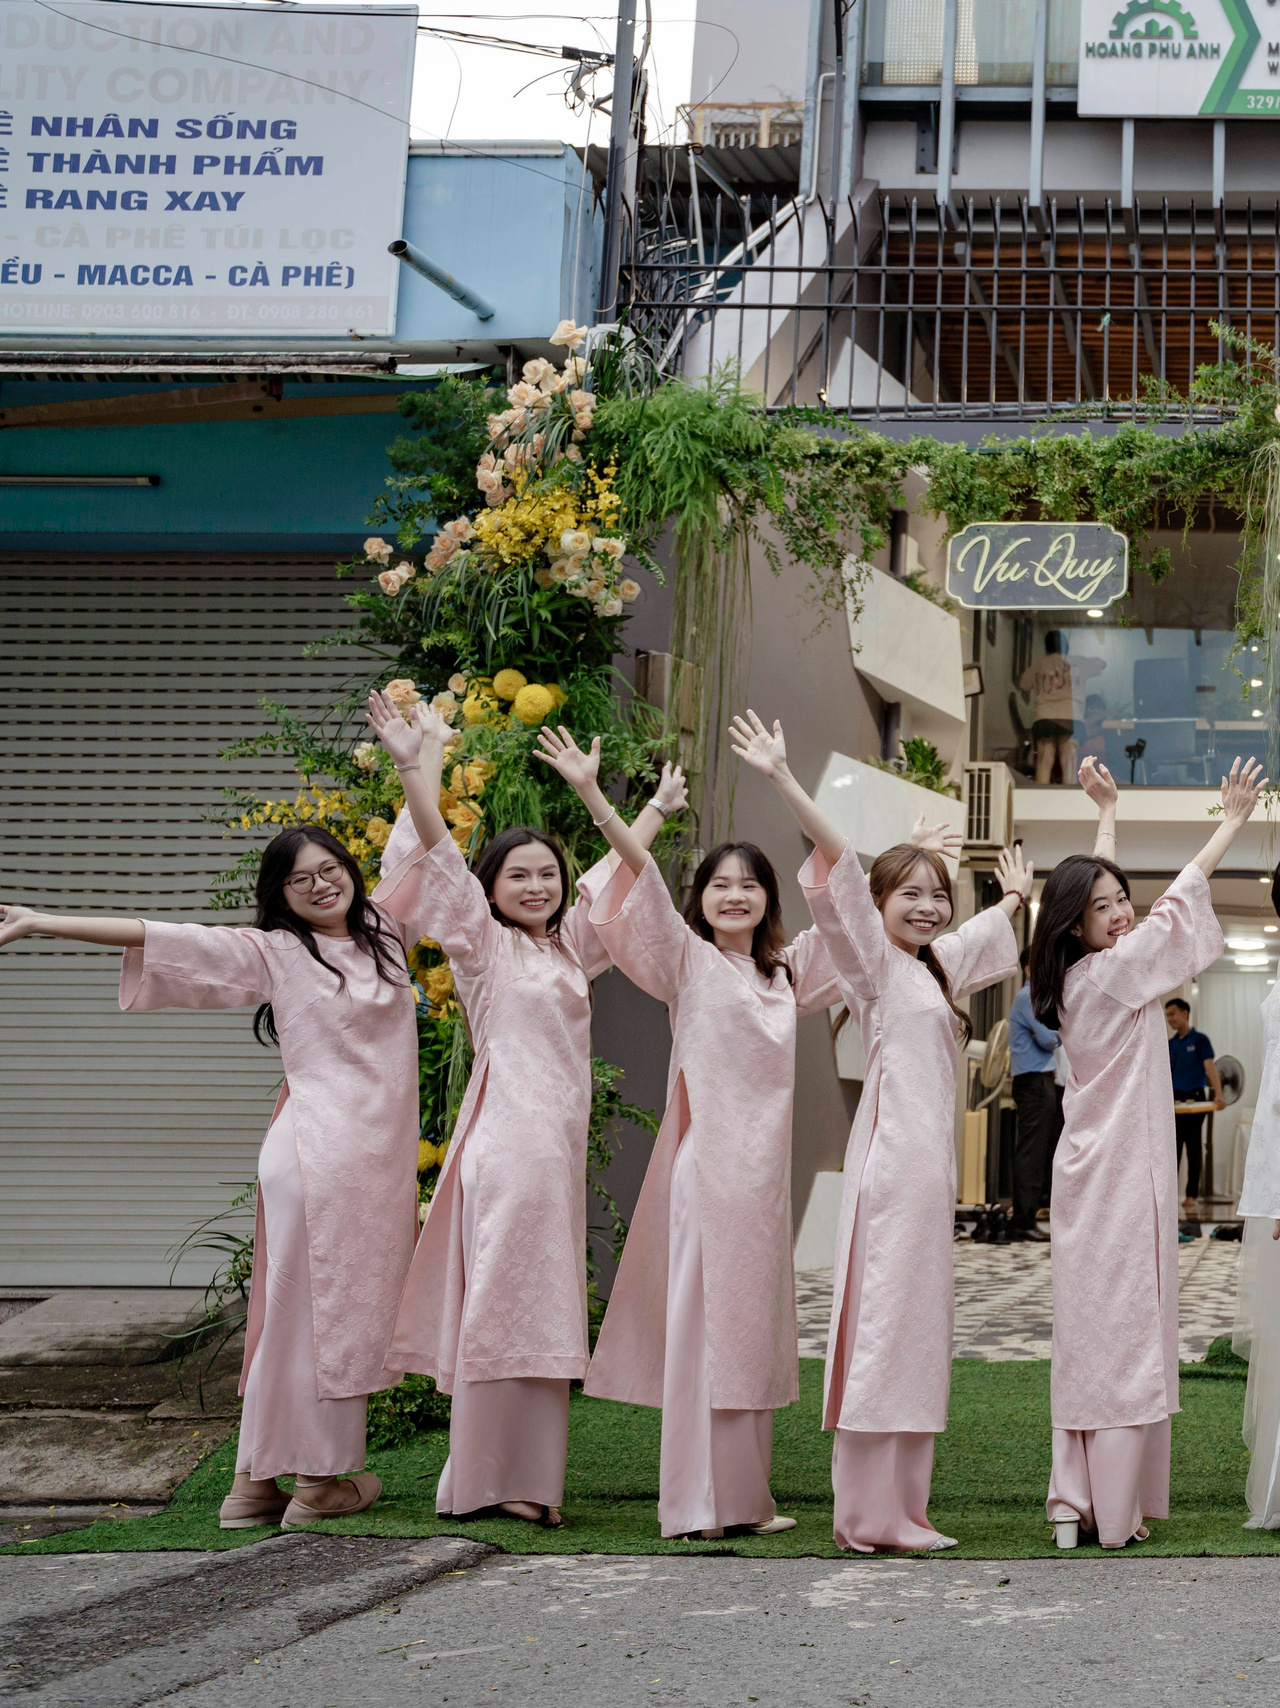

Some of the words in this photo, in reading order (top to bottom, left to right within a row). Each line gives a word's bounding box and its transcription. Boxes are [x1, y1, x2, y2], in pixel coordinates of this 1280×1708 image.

[4, 13, 245, 54] DUCTION
[263, 19, 374, 55] AND
[1085, 42, 1142, 60] HOANG
[1147, 42, 1181, 60] PHU
[1186, 42, 1221, 60] ANH
[106, 66, 372, 105] COMPANY
[30, 113, 160, 139] NHÂN
[174, 111, 298, 140] SỐNG
[26, 149, 178, 175] THÀNH
[192, 146, 325, 176] PHẨM
[25, 188, 149, 211] RANG
[163, 190, 246, 212] XAY
[34, 222, 90, 249] CÀ
[105, 223, 187, 249] PHÊ
[200, 223, 264, 250] TÚI
[278, 228, 356, 255] LỌC
[76, 264, 194, 287] MACCA
[228, 261, 270, 287] CÀ
[281, 261, 355, 289] PHÊ)
[81, 304, 126, 320] 0903
[131, 305, 163, 320] 600
[957, 535, 1031, 593] Vu
[1029, 533, 1116, 601] Quy
